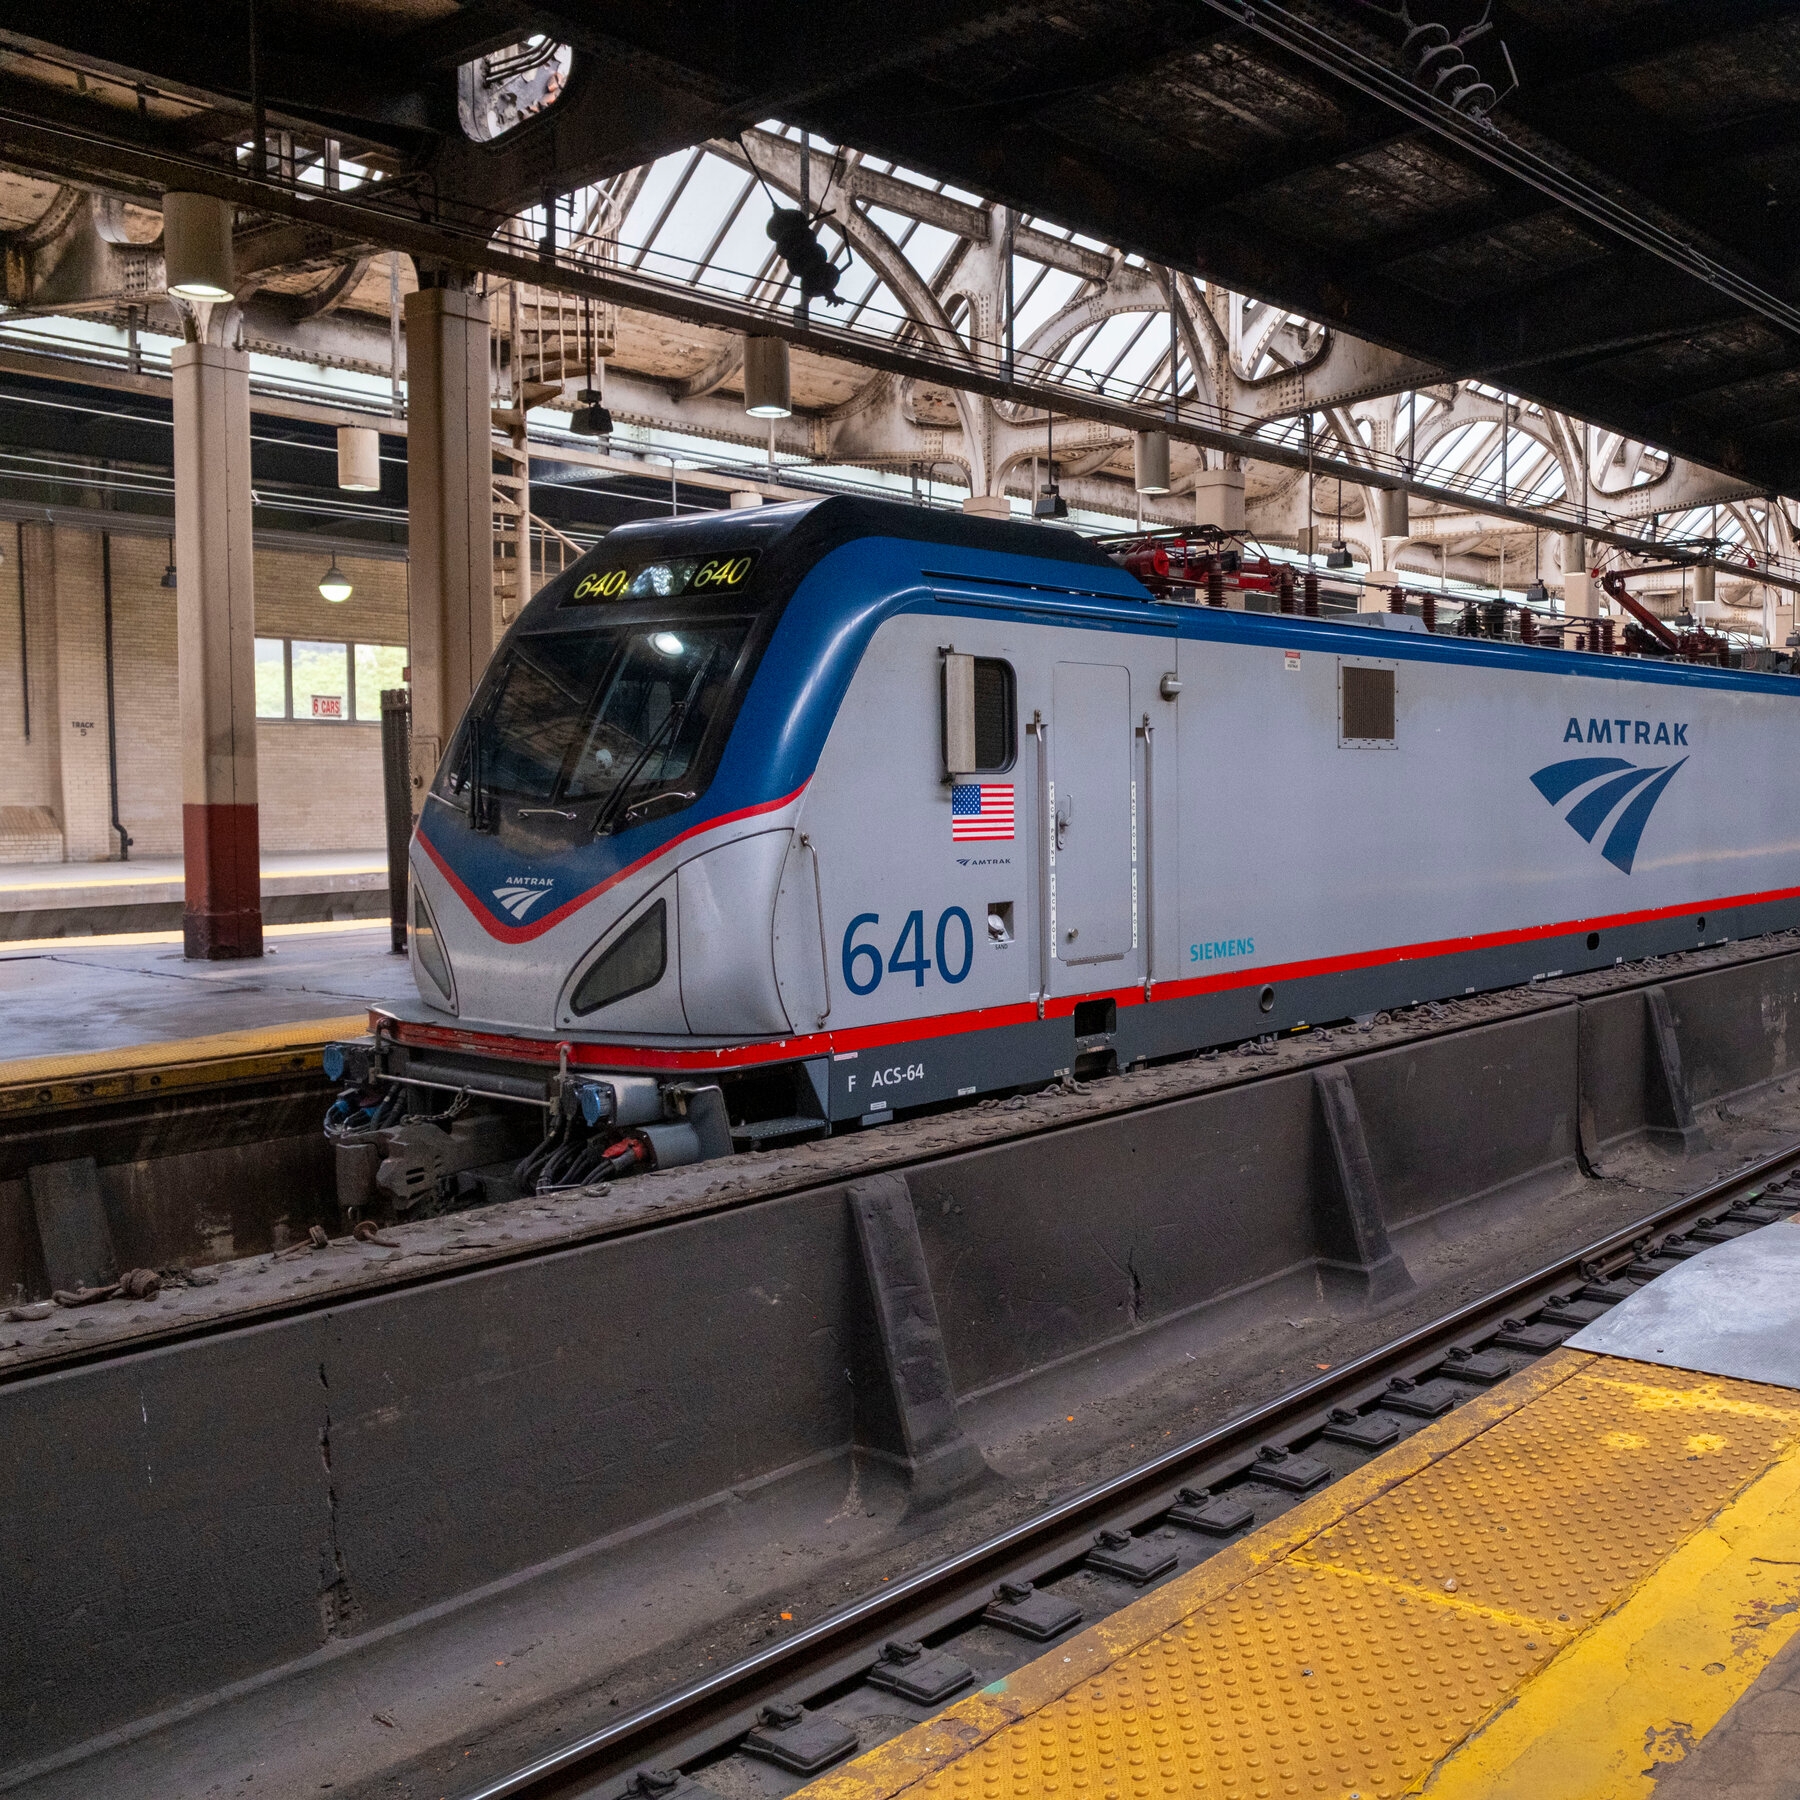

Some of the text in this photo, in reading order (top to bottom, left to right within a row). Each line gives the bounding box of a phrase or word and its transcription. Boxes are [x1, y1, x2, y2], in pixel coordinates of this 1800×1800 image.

[574, 570, 627, 599] 640
[694, 557, 752, 588] 640
[313, 698, 340, 713] 6 CARS
[80, 728, 87, 736] 5
[1563, 717, 1689, 746] AMTRAK
[971, 858, 1011, 866] AMTRAK
[505, 876, 555, 886] AMTRAK
[842, 906, 973, 996] 640
[1190, 937, 1255, 962] SIEMENS
[848, 1063, 925, 1092] F ACS-64
